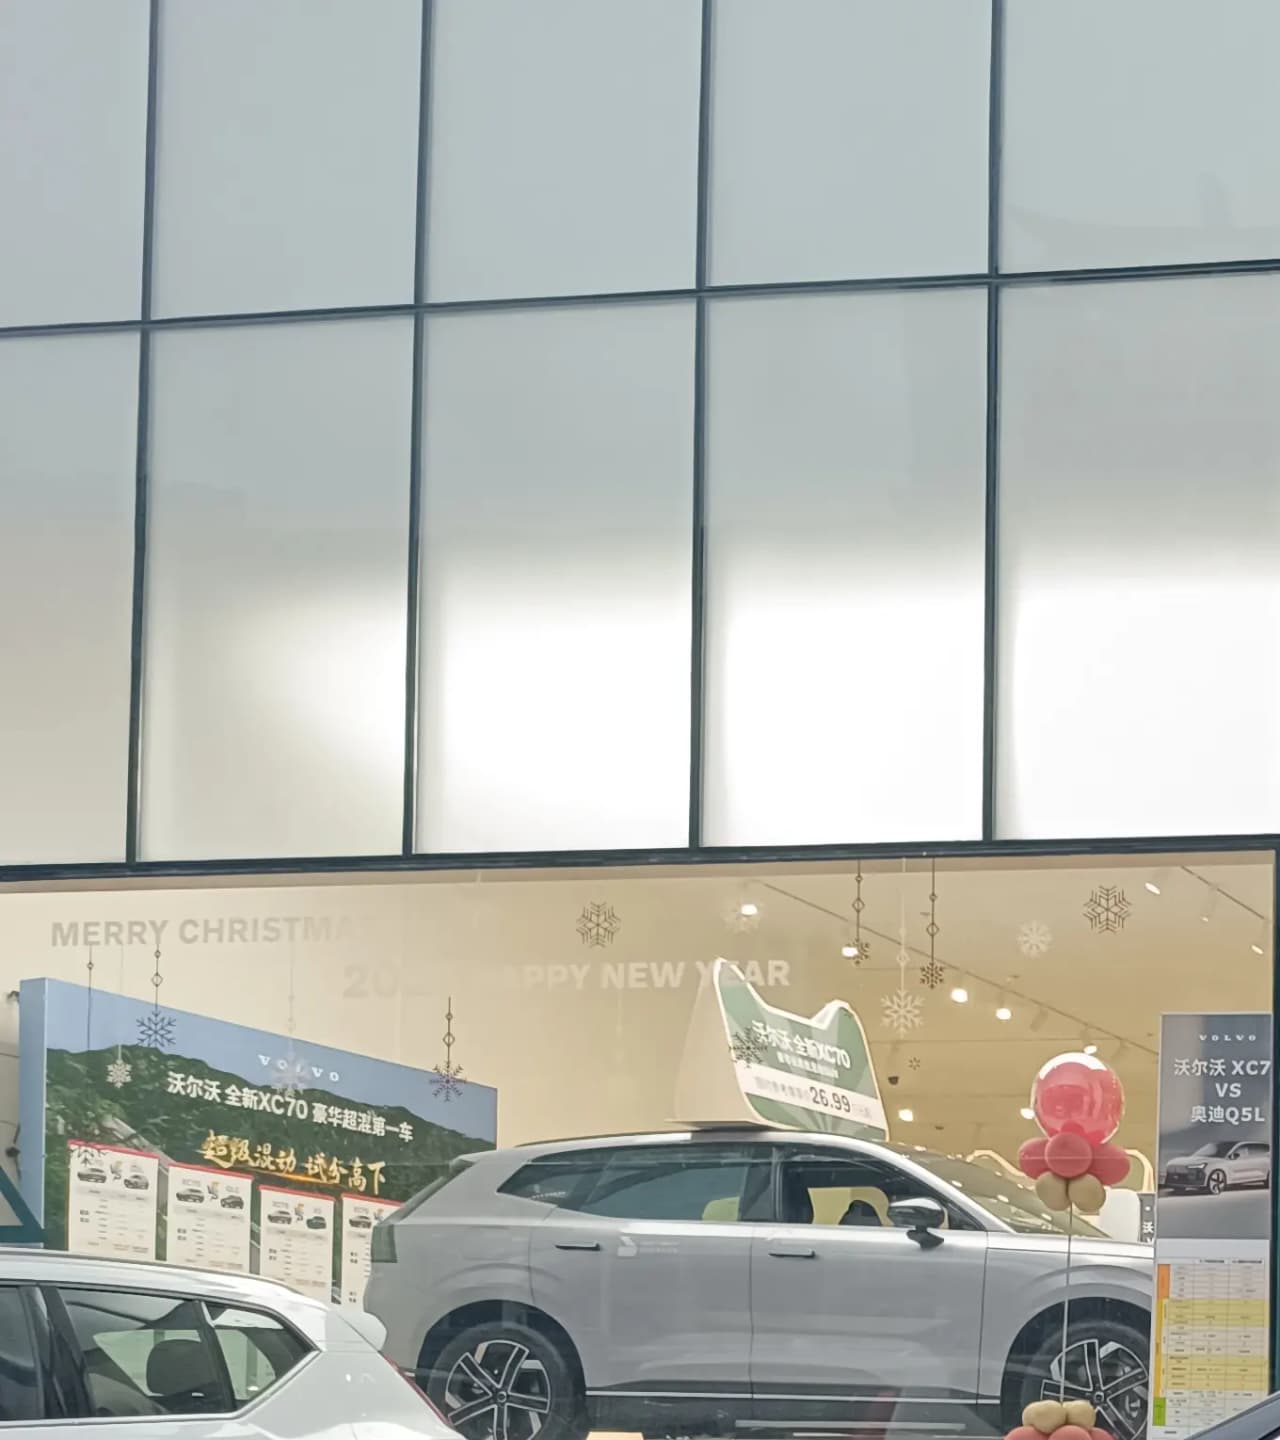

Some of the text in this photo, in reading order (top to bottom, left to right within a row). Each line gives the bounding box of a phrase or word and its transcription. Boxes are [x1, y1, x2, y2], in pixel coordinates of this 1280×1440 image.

[51, 917, 356, 947] MERRY CHRISTMA
[602, 961, 686, 989] NEW
[1199, 1034, 1256, 1042] VOLVO
[1174, 1058, 1272, 1076] 沃尔沃 XC7
[167, 1071, 221, 1103] 沃尔沃
[224, 1085, 308, 1120] 全新XC70
[809, 1086, 851, 1113] 26.99
[1215, 1083, 1241, 1098] VS
[1191, 1105, 1265, 1125] 奥迪Q5L
